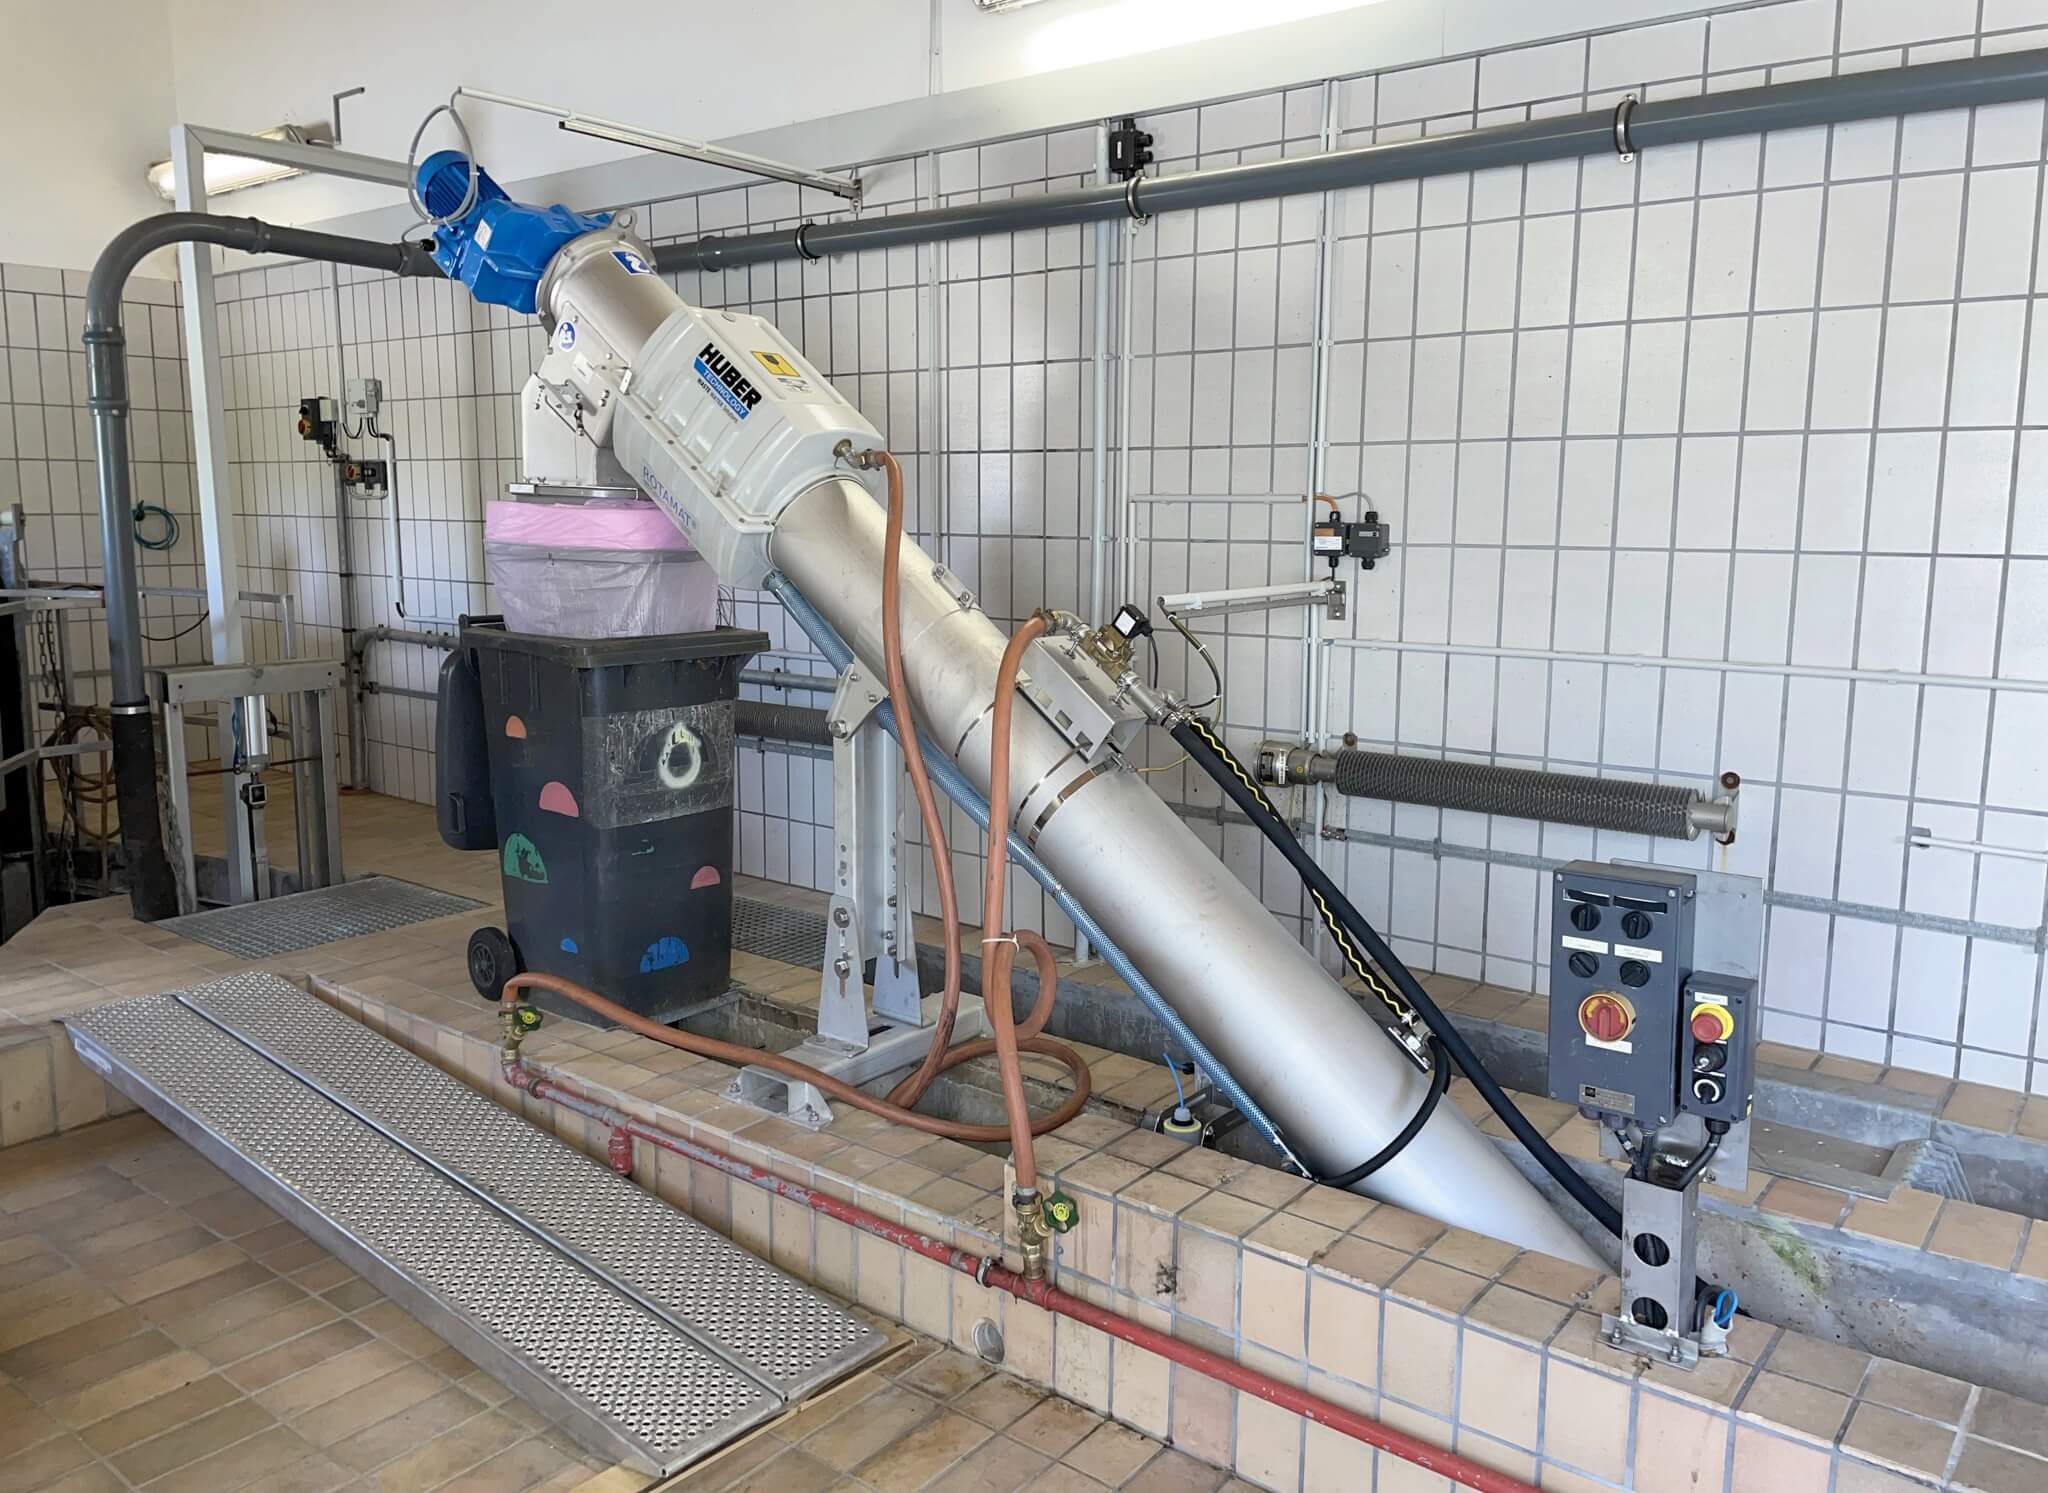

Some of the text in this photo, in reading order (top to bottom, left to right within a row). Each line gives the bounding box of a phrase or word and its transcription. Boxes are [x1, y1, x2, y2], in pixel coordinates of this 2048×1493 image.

[697, 377, 711, 393] WASTE
[698, 342, 762, 411] HUBER
[703, 369, 746, 416] TECHNOLOGY
